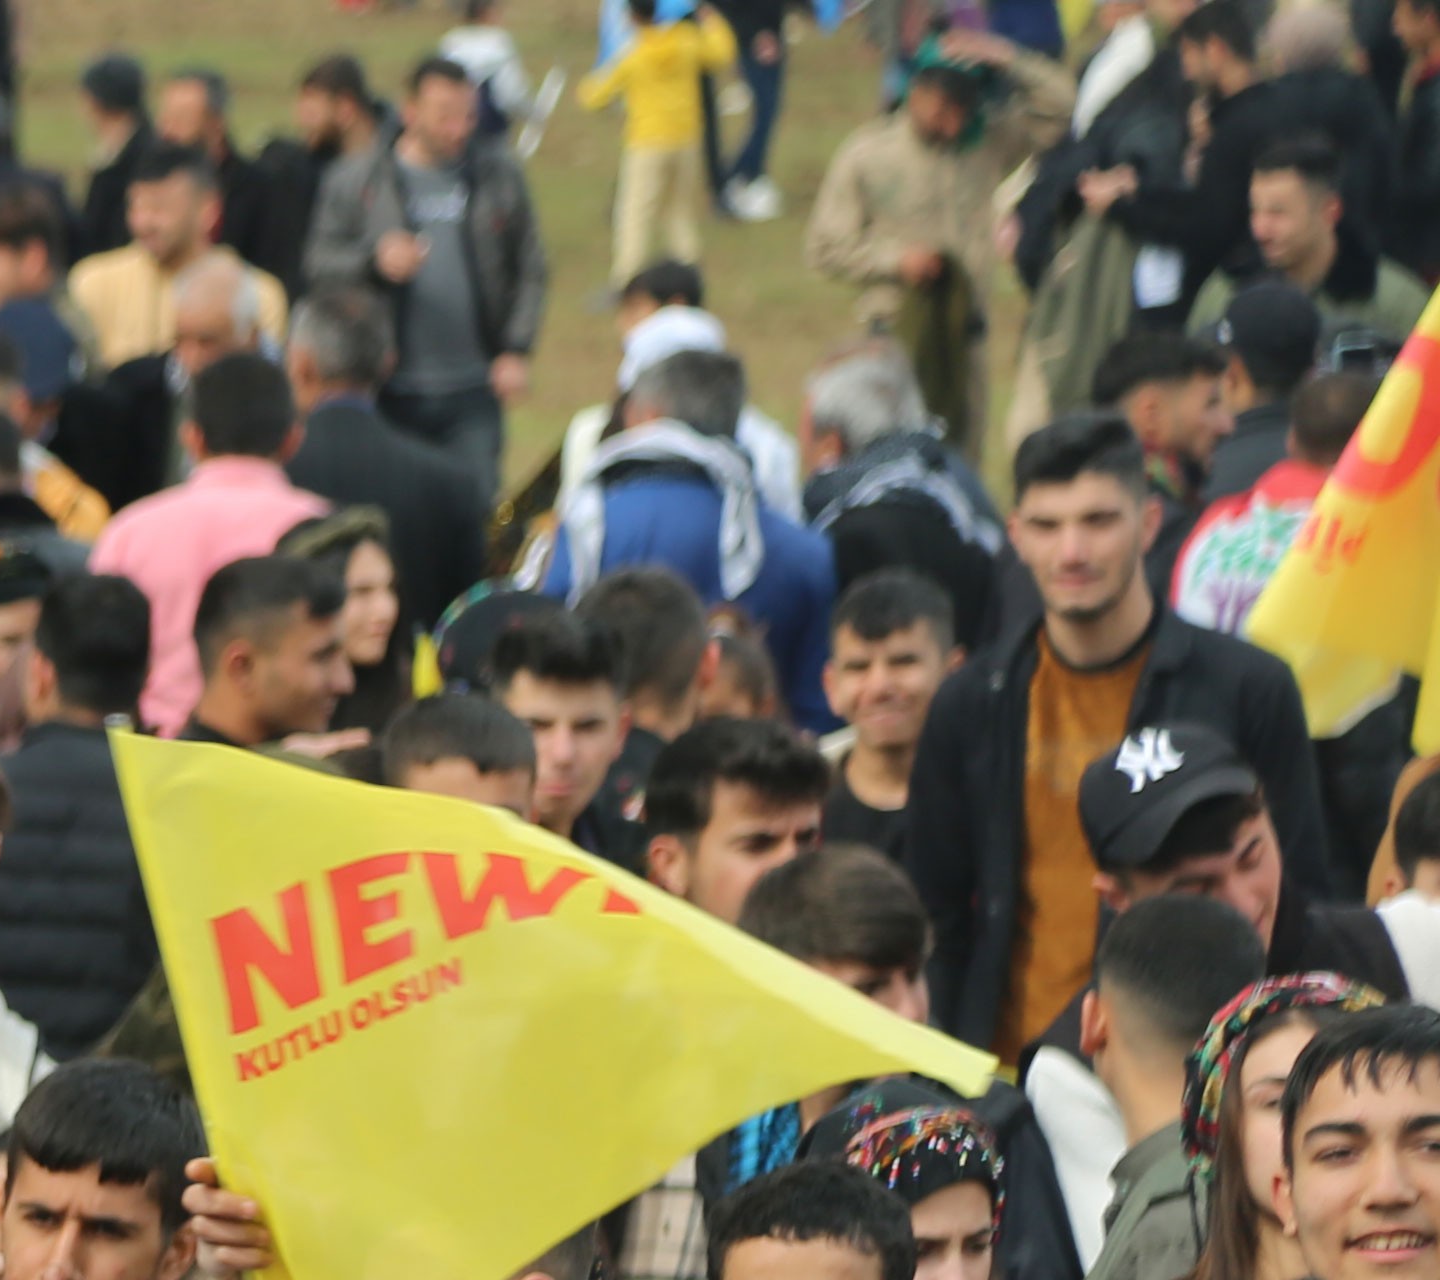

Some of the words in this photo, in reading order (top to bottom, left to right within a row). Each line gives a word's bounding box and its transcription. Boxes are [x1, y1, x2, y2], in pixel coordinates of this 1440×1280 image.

[210, 851, 643, 1036] NEW
[233, 1006, 345, 1084] KUTLU
[348, 956, 464, 1032] OLSUN
